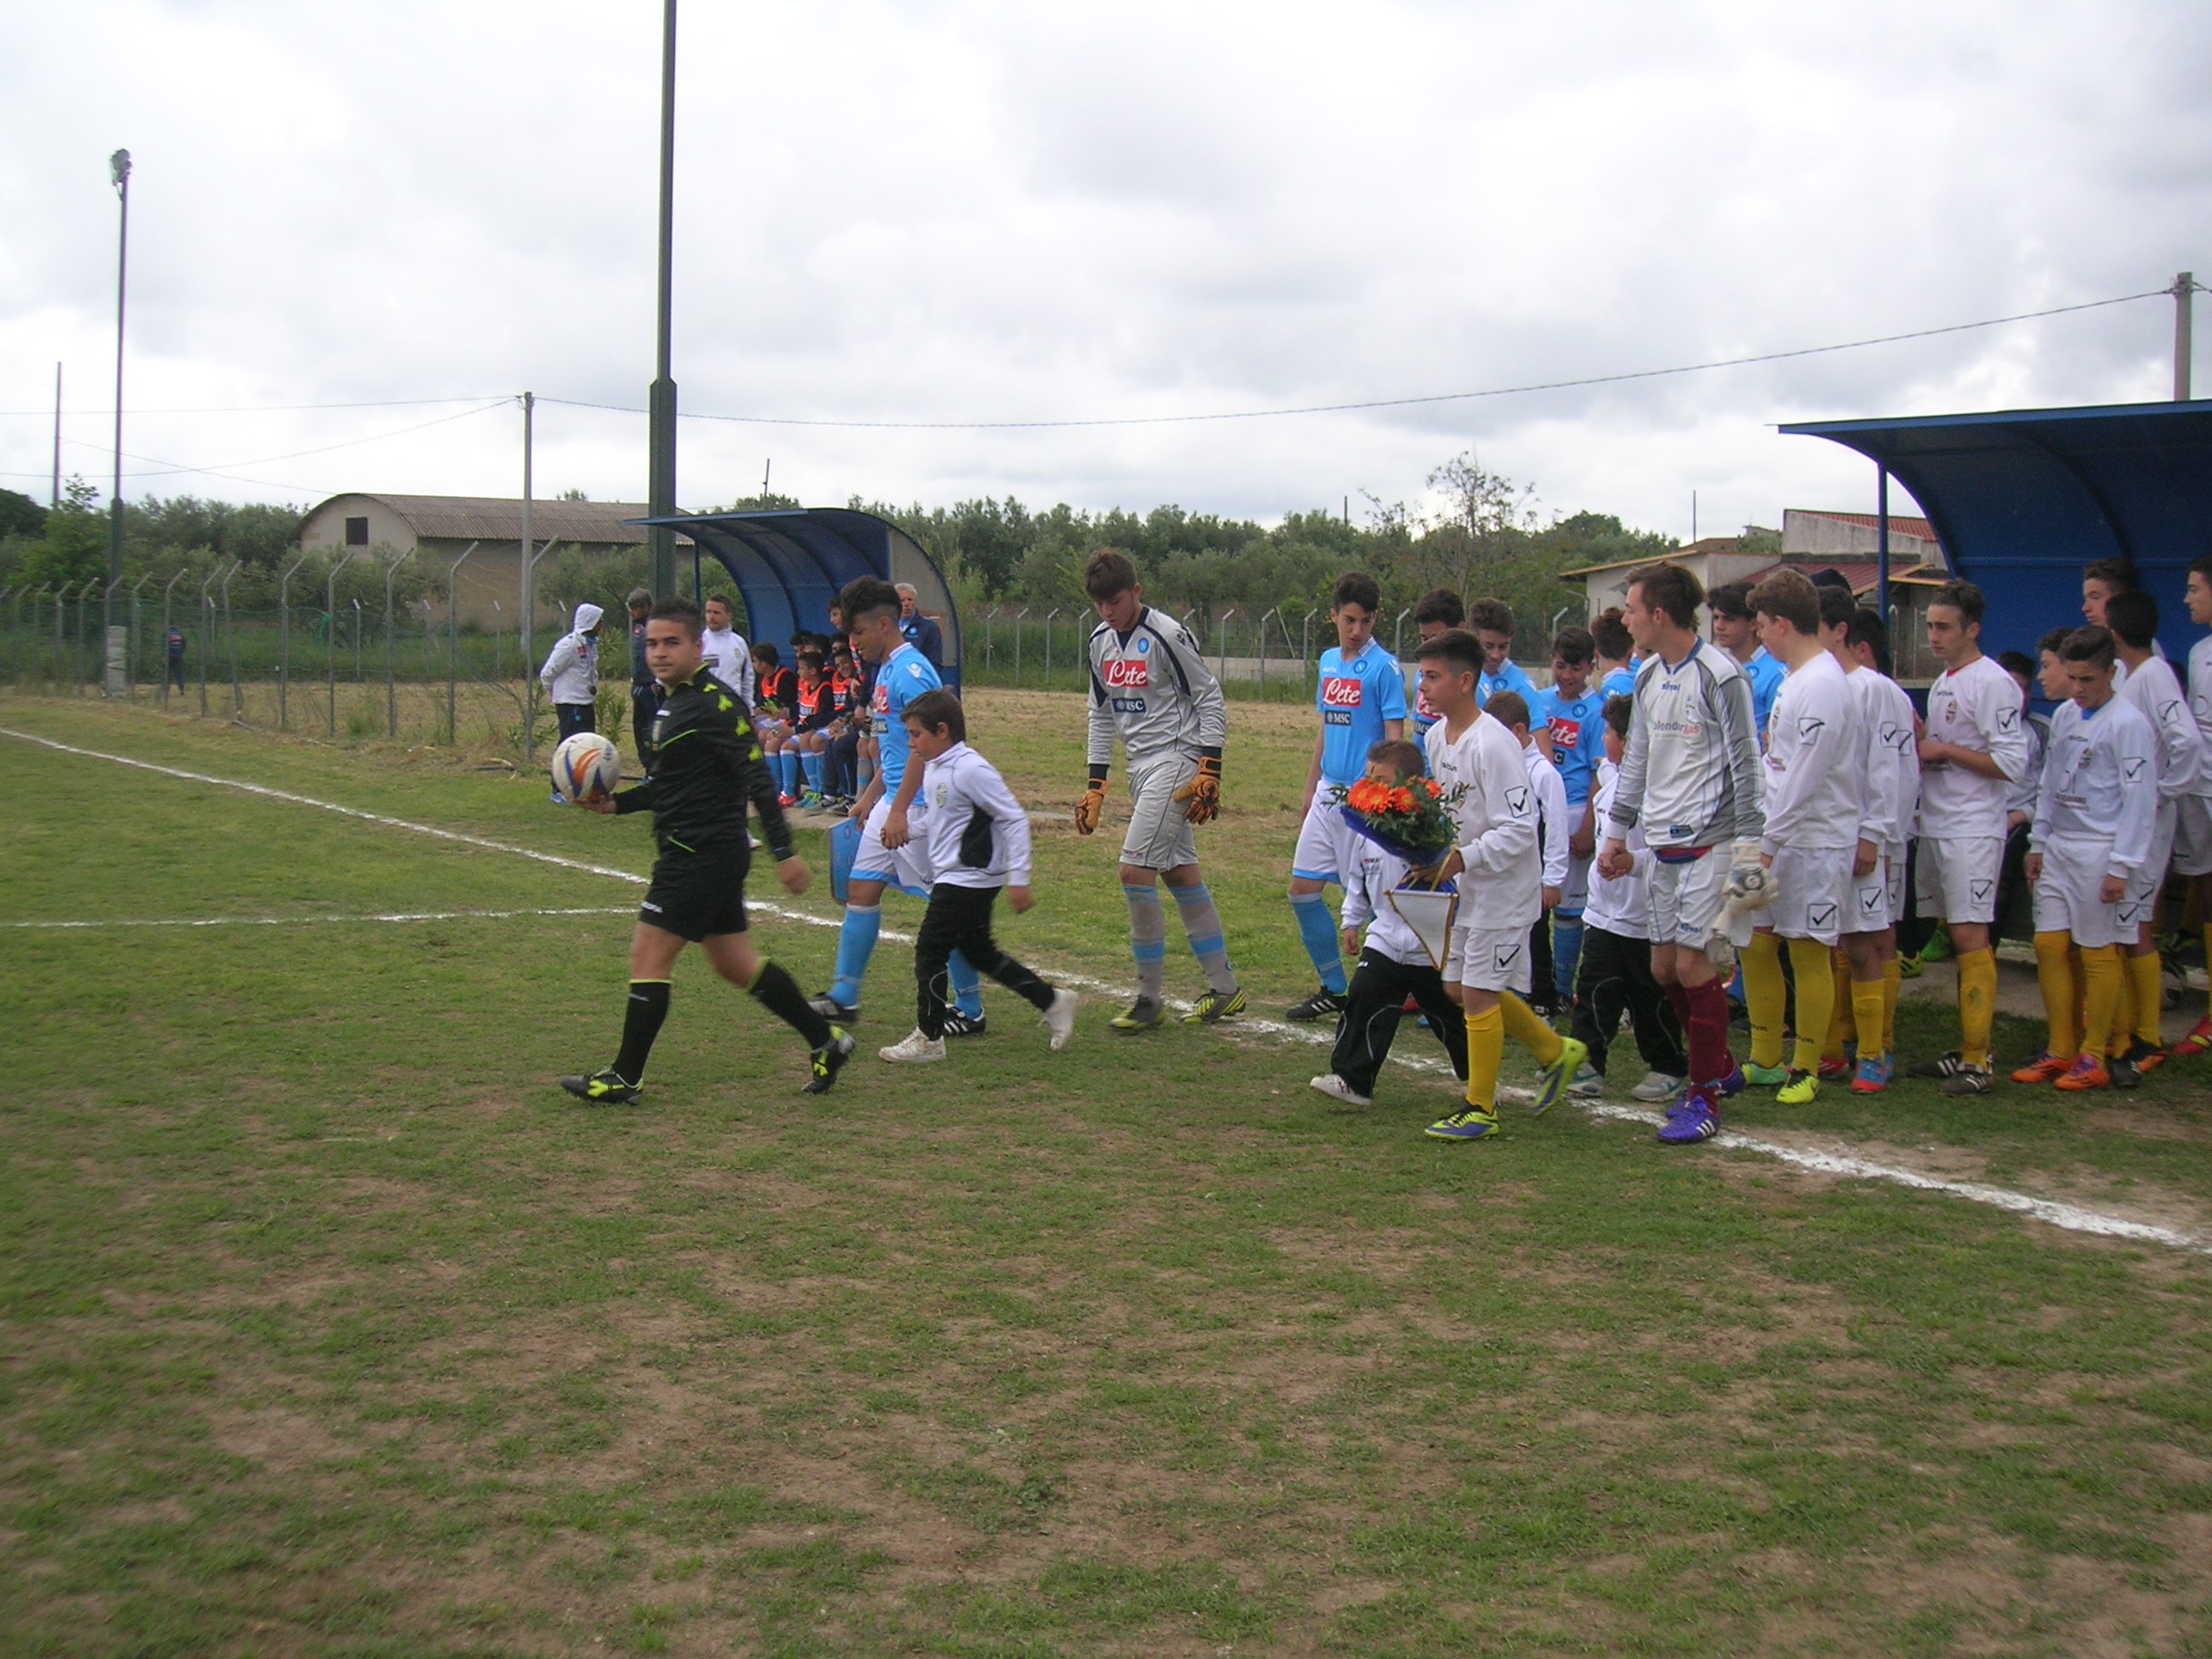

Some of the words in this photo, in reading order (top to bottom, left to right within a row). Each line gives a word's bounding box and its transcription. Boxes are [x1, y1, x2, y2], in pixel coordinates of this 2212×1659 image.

[1106, 661, 1147, 687] Lete
[1324, 678, 1360, 705] Lete
[1333, 713, 1350, 724] MSC
